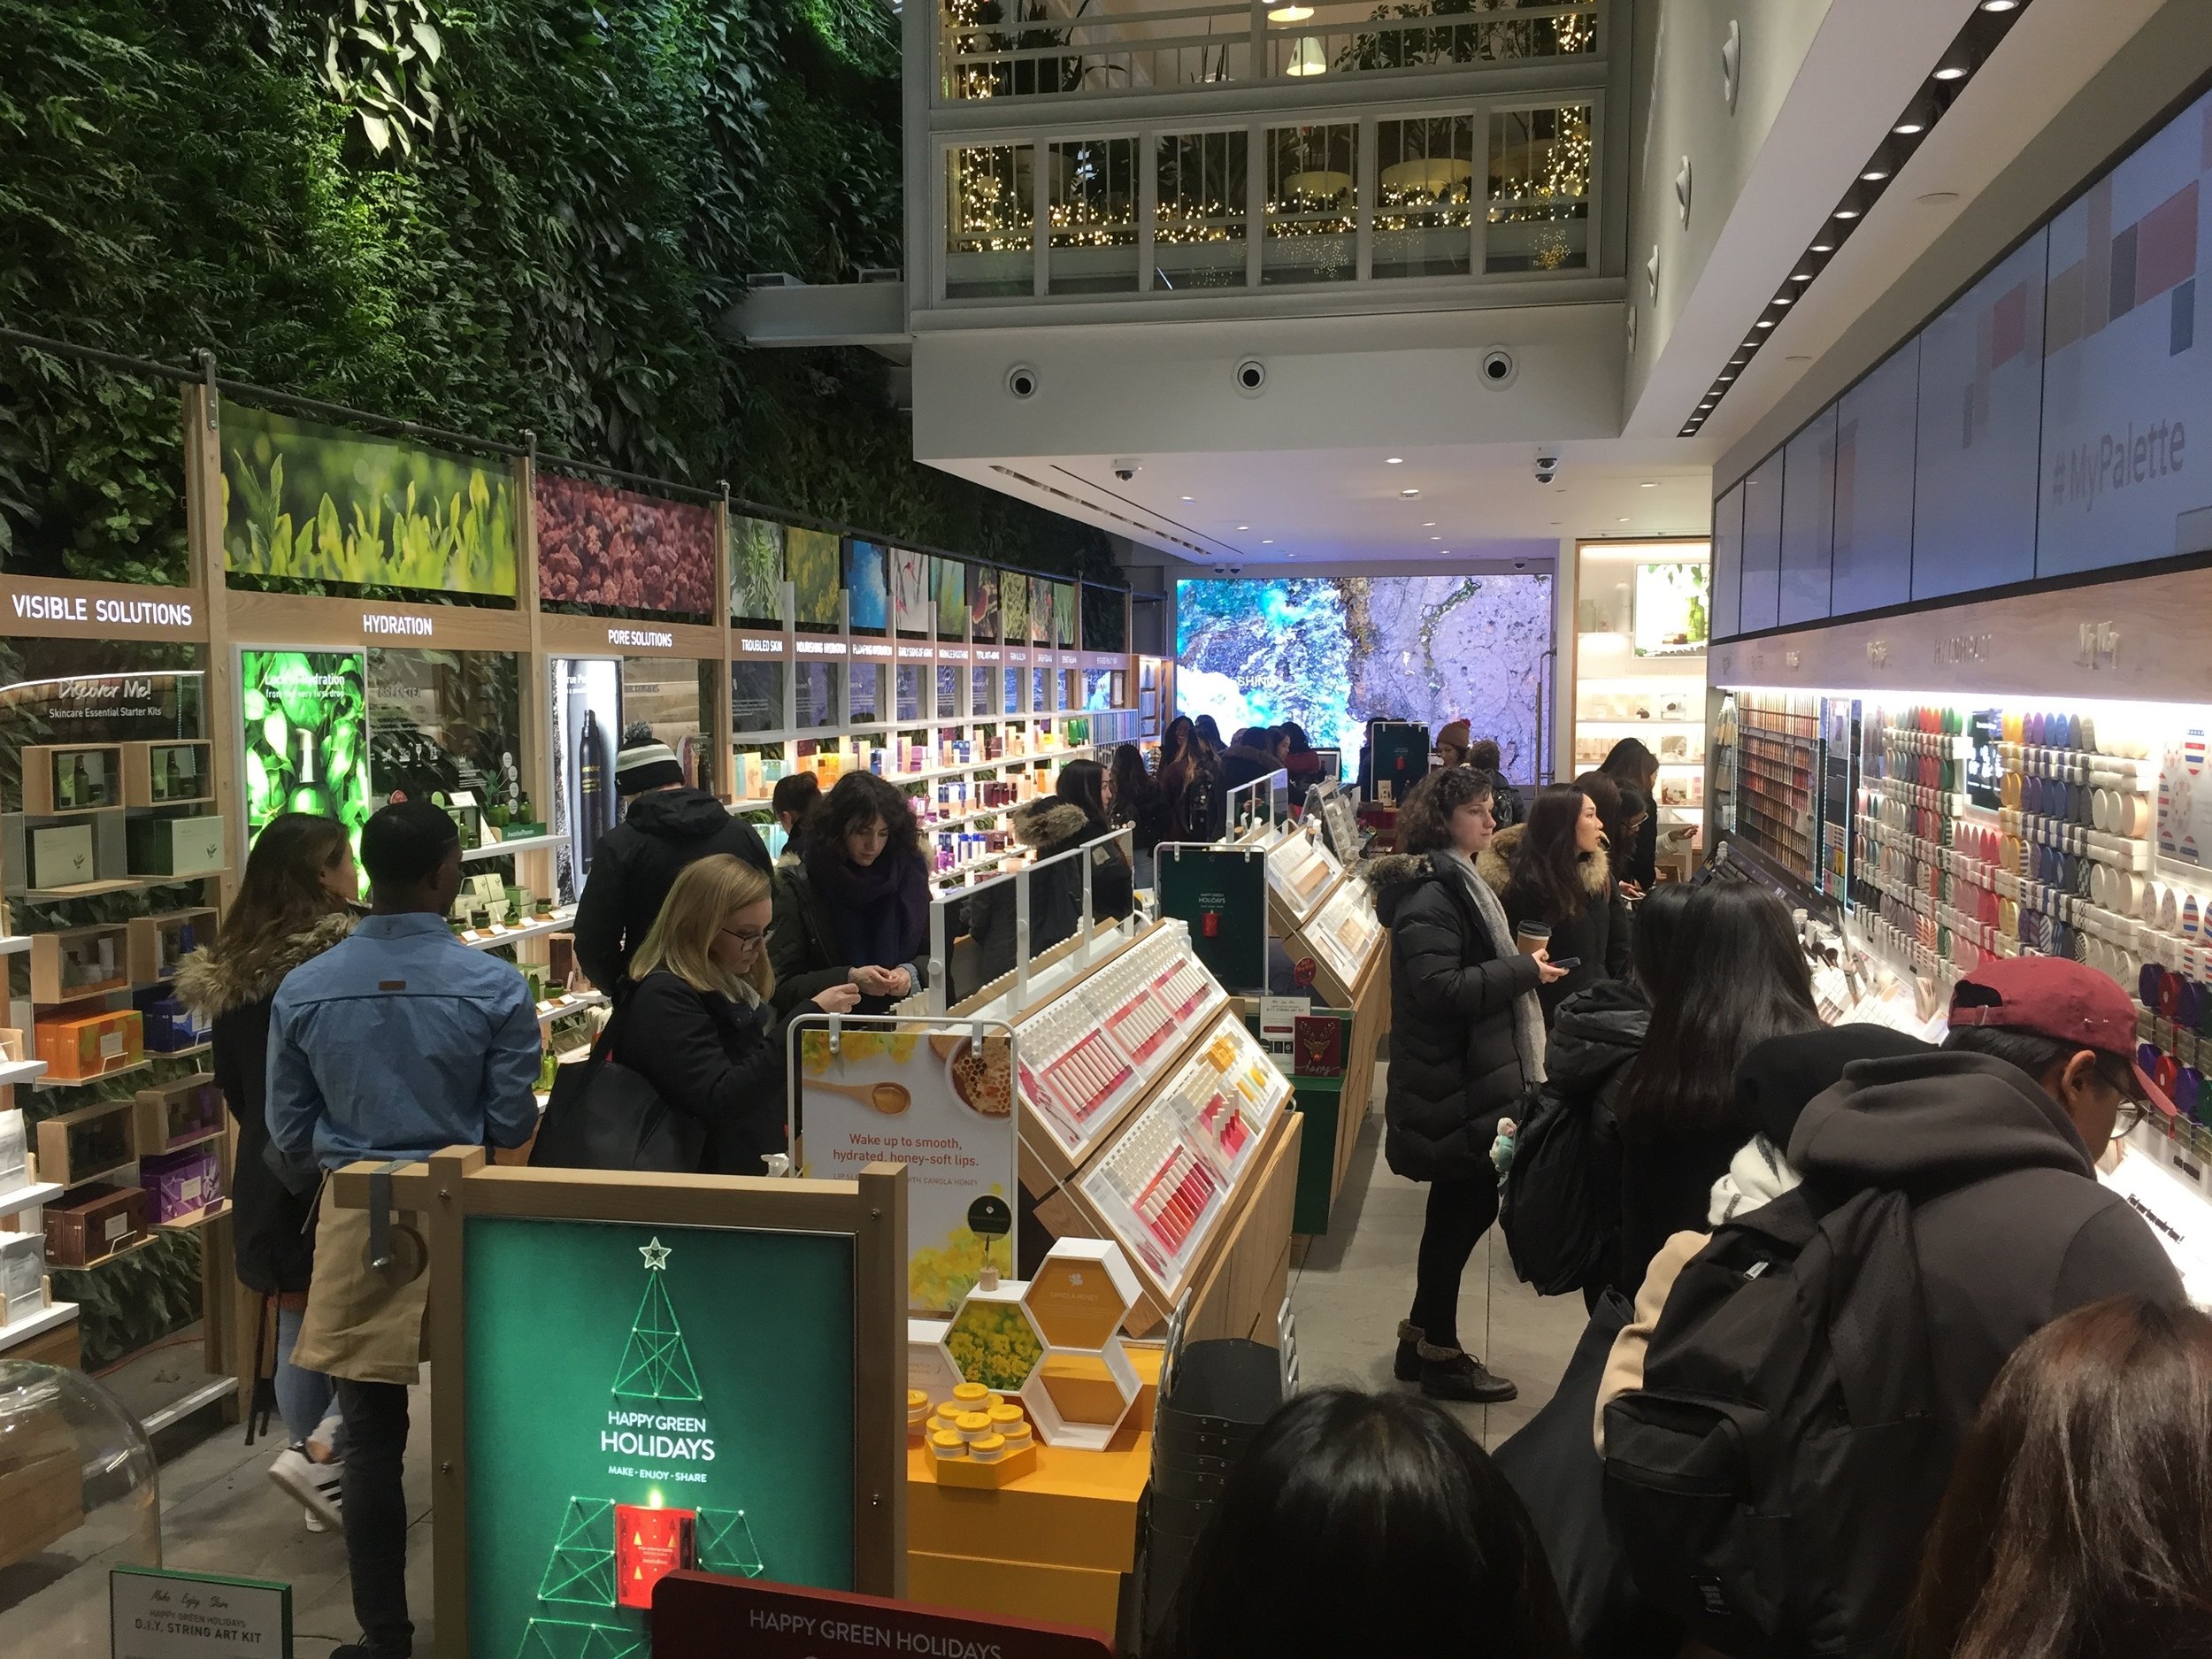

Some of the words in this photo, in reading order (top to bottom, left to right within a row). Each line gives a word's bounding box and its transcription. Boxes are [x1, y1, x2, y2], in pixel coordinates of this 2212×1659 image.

[2052, 417, 2185, 513] #MyPalette
[11, 594, 88, 621] VISIBLE
[96, 599, 193, 626] SOLUTIONS
[363, 614, 433, 636] HYDRATION
[608, 629, 630, 647] PORE
[631, 630, 672, 648] SOLUTIONS
[741, 639, 769, 652] TROUBLED
[770, 640, 783, 653] SKIN
[58, 678, 118, 700] Discover
[123, 678, 152, 700] Me!
[49, 707, 83, 718] Skincare
[85, 707, 119, 718] Essential
[120, 707, 144, 717] Starter
[145, 706, 162, 716] Kits
[849, 1133, 881, 1146] Wake
[884, 1137, 898, 1148] up
[902, 1136, 912, 1147] to
[915, 1138, 963, 1150] smooth,
[890, 1152, 952, 1166] honey-soft
[955, 1155, 979, 1168] lips.
[954, 1178, 979, 1187] HONEY
[608, 1410, 655, 1429] HAPPY
[656, 1416, 706, 1433] GREEN
[601, 1430, 716, 1461] HOLIDAYS
[608, 1465, 634, 1477] MAKE
[639, 1469, 669, 1480] ENJOY
[675, 1472, 707, 1483] SHARE
[150, 1589, 172, 1602] Make
[180, 1593, 200, 1609] Enjoy
[210, 1595, 228, 1609] Share
[149, 1609, 177, 1619] HAPPY
[178, 1611, 206, 1624] GREEN
[207, 1615, 247, 1628] HOLIDAYS
[134, 1618, 164, 1632] D.I.Y.
[166, 1623, 211, 1638] STRING
[214, 1628, 237, 1641] ART
[241, 1631, 262, 1644] KIT
[750, 1608, 818, 1637] HAPPY
[819, 1619, 891, 1648] GREEN
[896, 1631, 1002, 1659] HOLIDAYS
